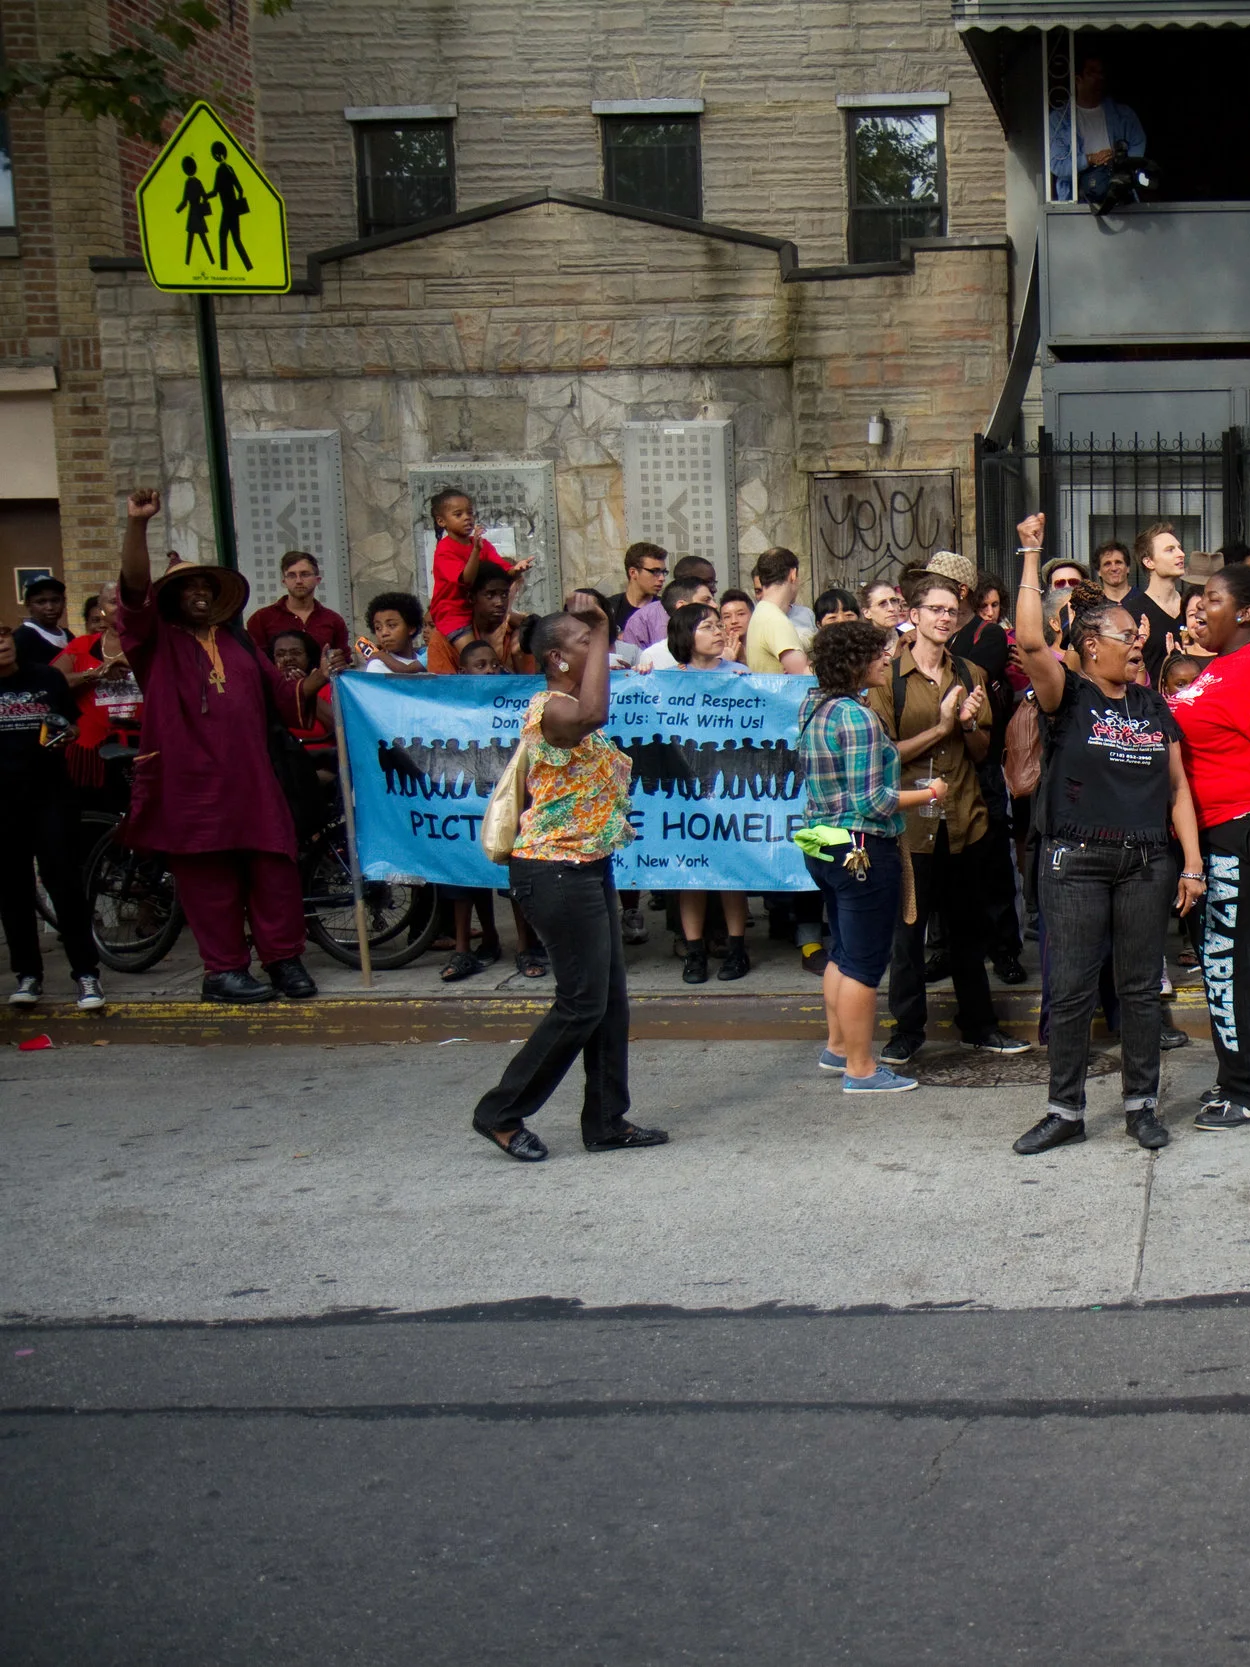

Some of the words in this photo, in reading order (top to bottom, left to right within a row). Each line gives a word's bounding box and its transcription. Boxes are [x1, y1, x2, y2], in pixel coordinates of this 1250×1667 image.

[668, 693, 695, 707] and
[701, 694, 766, 711] Respect:
[624, 712, 649, 725] Us:
[656, 712, 689, 726] Talk
[696, 714, 734, 729] With
[740, 715, 764, 729] Us!
[637, 854, 670, 868] New
[676, 854, 710, 868] York
